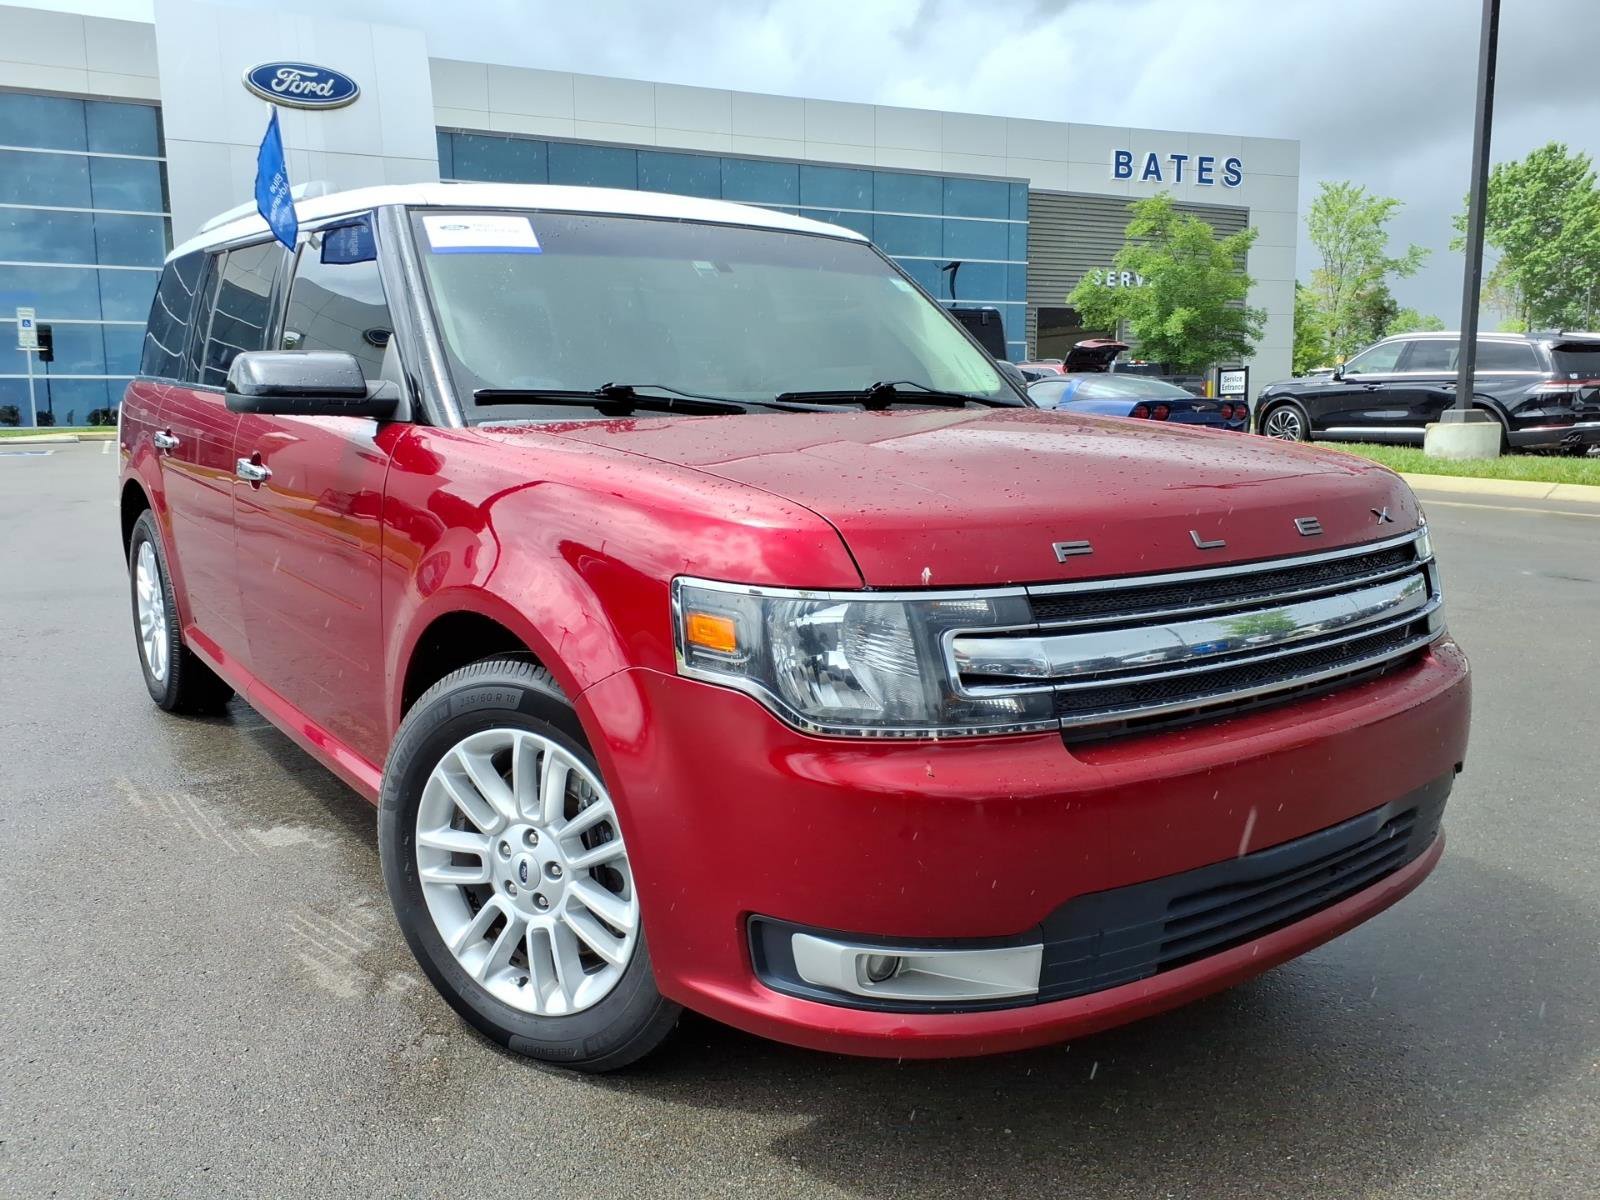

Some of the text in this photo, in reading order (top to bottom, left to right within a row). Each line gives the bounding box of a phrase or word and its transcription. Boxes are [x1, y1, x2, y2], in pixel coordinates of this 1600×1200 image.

[271, 68, 335, 97] Ford
[1111, 149, 1243, 188] BATES
[1094, 270, 1146, 288] SERV
[1221, 383, 1245, 391] Entrance
[1223, 375, 1244, 383] Service
[1052, 506, 1394, 563] FLEX
